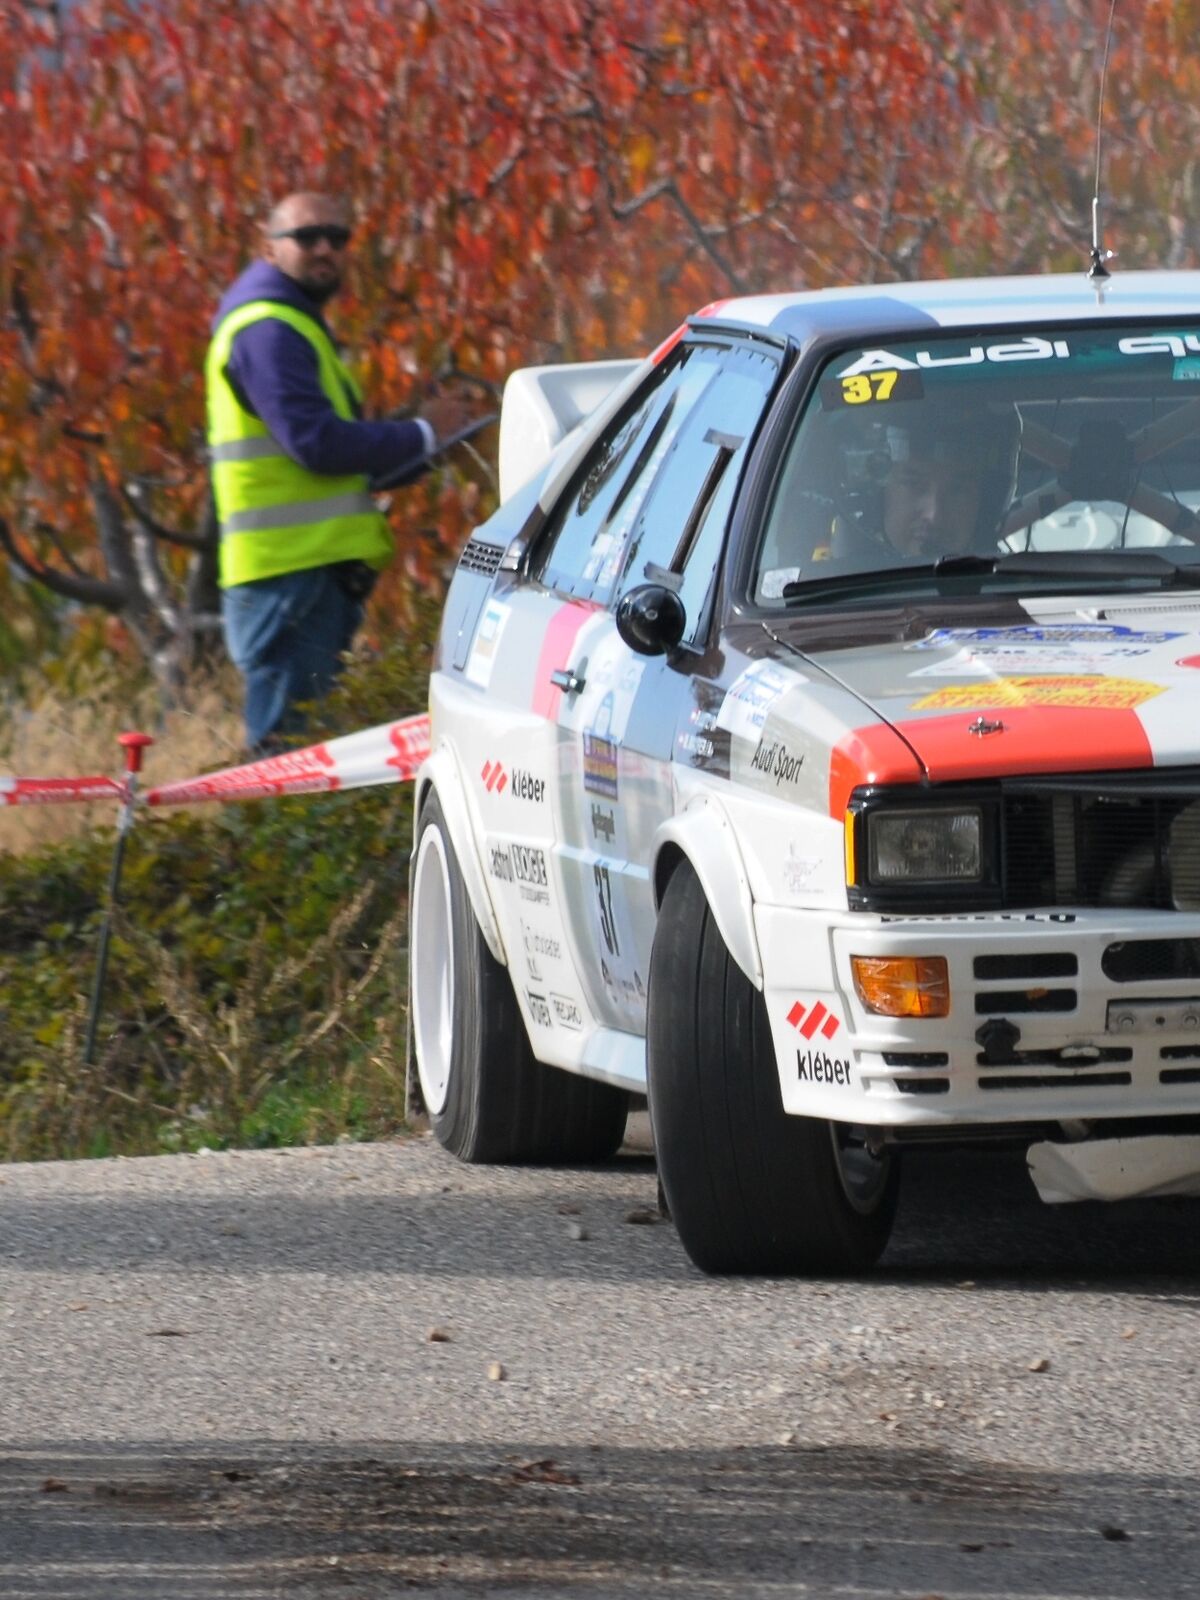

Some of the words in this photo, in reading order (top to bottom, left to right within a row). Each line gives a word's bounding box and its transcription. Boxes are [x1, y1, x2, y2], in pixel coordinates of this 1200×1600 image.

[836, 336, 1070, 379] Audi
[842, 370, 899, 404] 37
[750, 737, 779, 774] Audi
[773, 745, 805, 787] Sport
[796, 1048, 851, 1085] kléber
